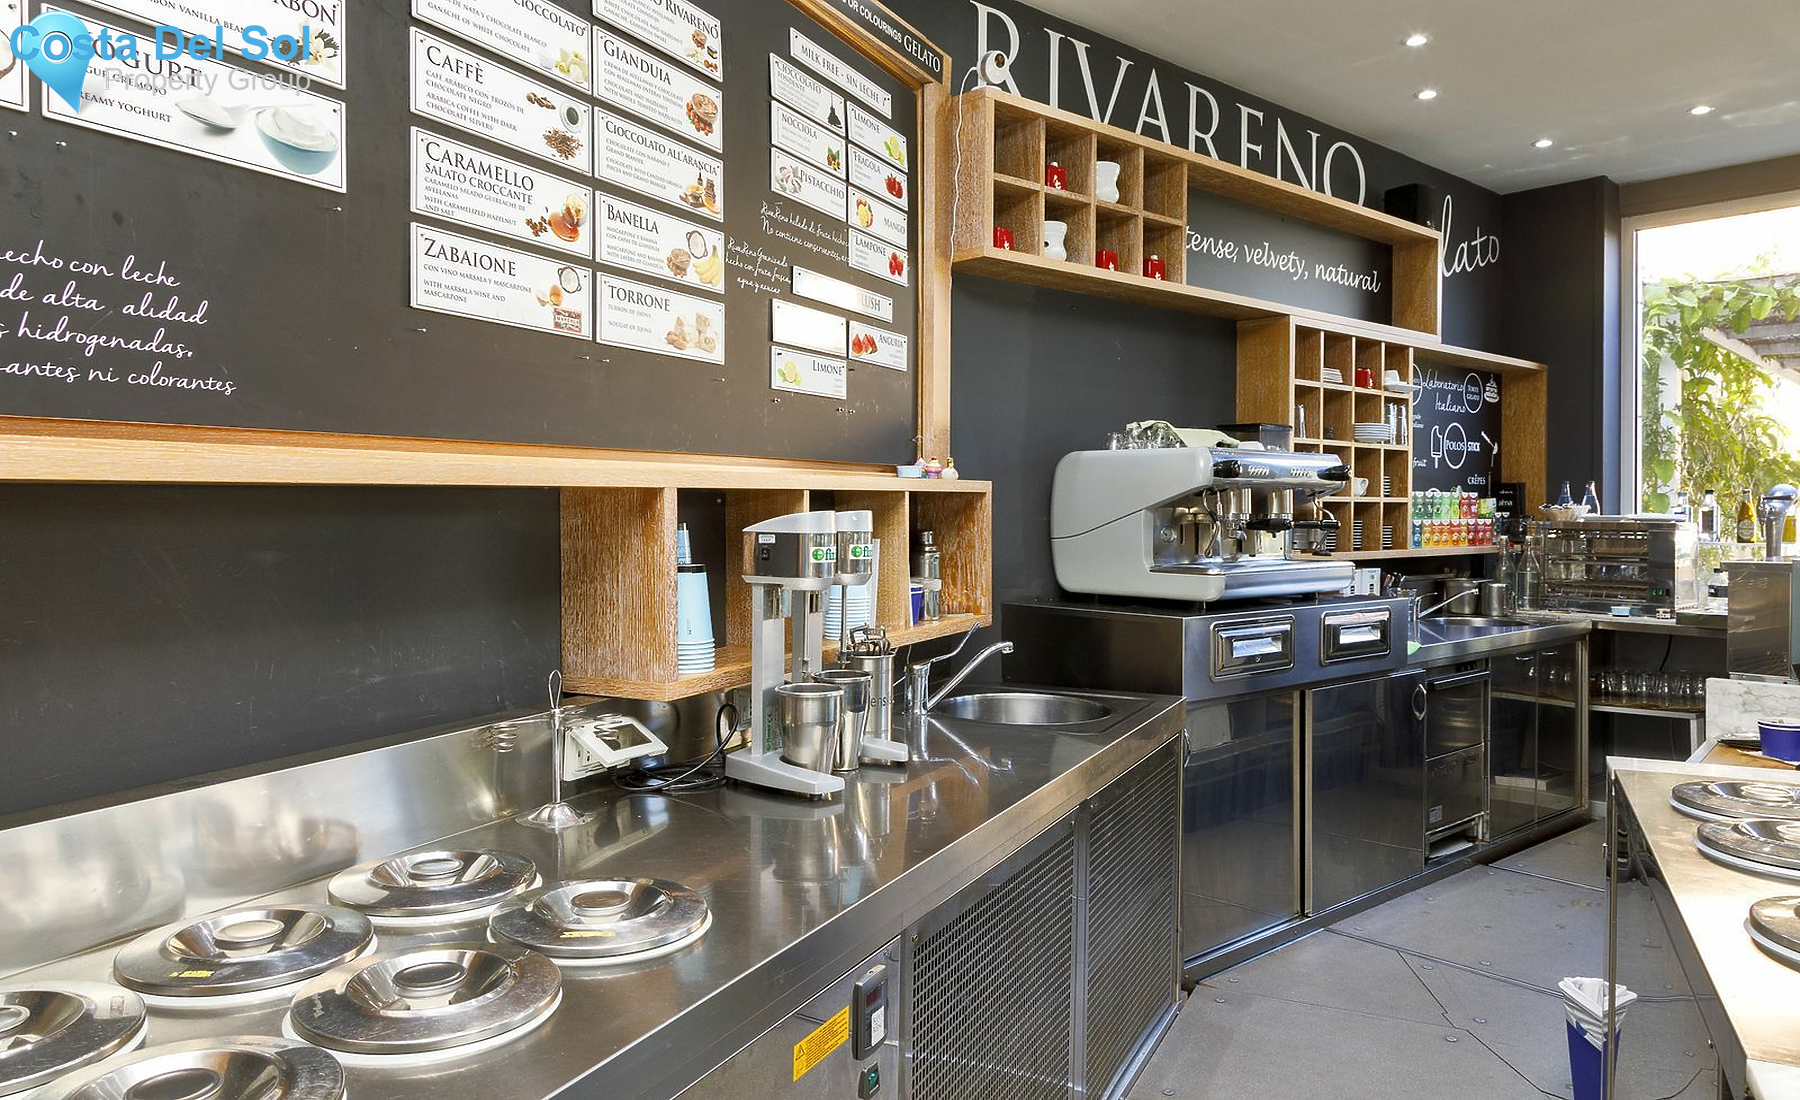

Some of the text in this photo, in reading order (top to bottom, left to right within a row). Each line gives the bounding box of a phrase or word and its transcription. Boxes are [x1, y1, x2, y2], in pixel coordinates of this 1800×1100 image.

[179, 4, 220, 26] VANILLA
[470, 20, 493, 36] WHITE
[494, 31, 529, 53] CHOCOLATE
[486, 14, 521, 36] CHOCOLATE
[523, 31, 547, 48] BLANCO
[859, 5, 902, 43] COLOURINGS
[904, 35, 940, 72] GELATO
[89, 34, 201, 89] OGURT
[426, 41, 483, 85] CAFFÈ
[603, 37, 671, 86] GIANDUIA
[801, 42, 879, 103] MILK FREE SIN LECHE
[777, 60, 821, 95] CIOCCOLATO
[426, 78, 491, 110] CHOCOLATE NEGRO
[474, 88, 489, 100] CON
[491, 95, 515, 110] TROZOS
[970, 0, 1366, 206] RIVARENO
[118, 101, 171, 124] YOGHURT
[426, 91, 517, 132] ARABICA COFFEE WITH DARK
[426, 100, 493, 131] CHOCOLATE SLIVERS
[781, 112, 817, 140] NOCCIOLA
[853, 108, 879, 134] LIMONE
[605, 118, 665, 154] CIOCCOLATO
[425, 138, 533, 192] CARAMELLO
[854, 151, 880, 174] FRAGOLA
[424, 161, 532, 205] SALATO CROCCANTE
[424, 176, 458, 192] CARAMELO
[424, 184, 458, 200] AVELLANAS
[800, 169, 844, 200] PISTACCHIO
[424, 202, 454, 216] AND SALT
[424, 194, 516, 226] WITH CARAMELIZED HAZELNUT
[607, 203, 658, 234] BANELLA
[883, 216, 905, 235] MANGO
[424, 236, 516, 277] ZABAIONE
[855, 234, 885, 257] LAMPONE
[70, 260, 114, 277] con
[121, 255, 180, 287] leche
[423, 263, 438, 272] CON
[440, 267, 457, 277] VINO
[459, 271, 486, 283] MARSALA
[493, 279, 531, 293] MASCARPONE
[1244, 244, 1308, 280] velvety,
[1316, 262, 1382, 293] natural
[42, 280, 106, 311] alta
[423, 279, 505, 302] WITH MARSALA WINE AND
[424, 288, 467, 303] MASCARPONE
[609, 284, 670, 312] TORRONE
[18, 311, 193, 358] hidrogenadas.
[878, 333, 902, 348] ANGURIA
[88, 368, 120, 382] ni
[128, 361, 237, 396] colorantes
[812, 359, 842, 375] LIMONE
[1435, 392, 1466, 413] Italiano
